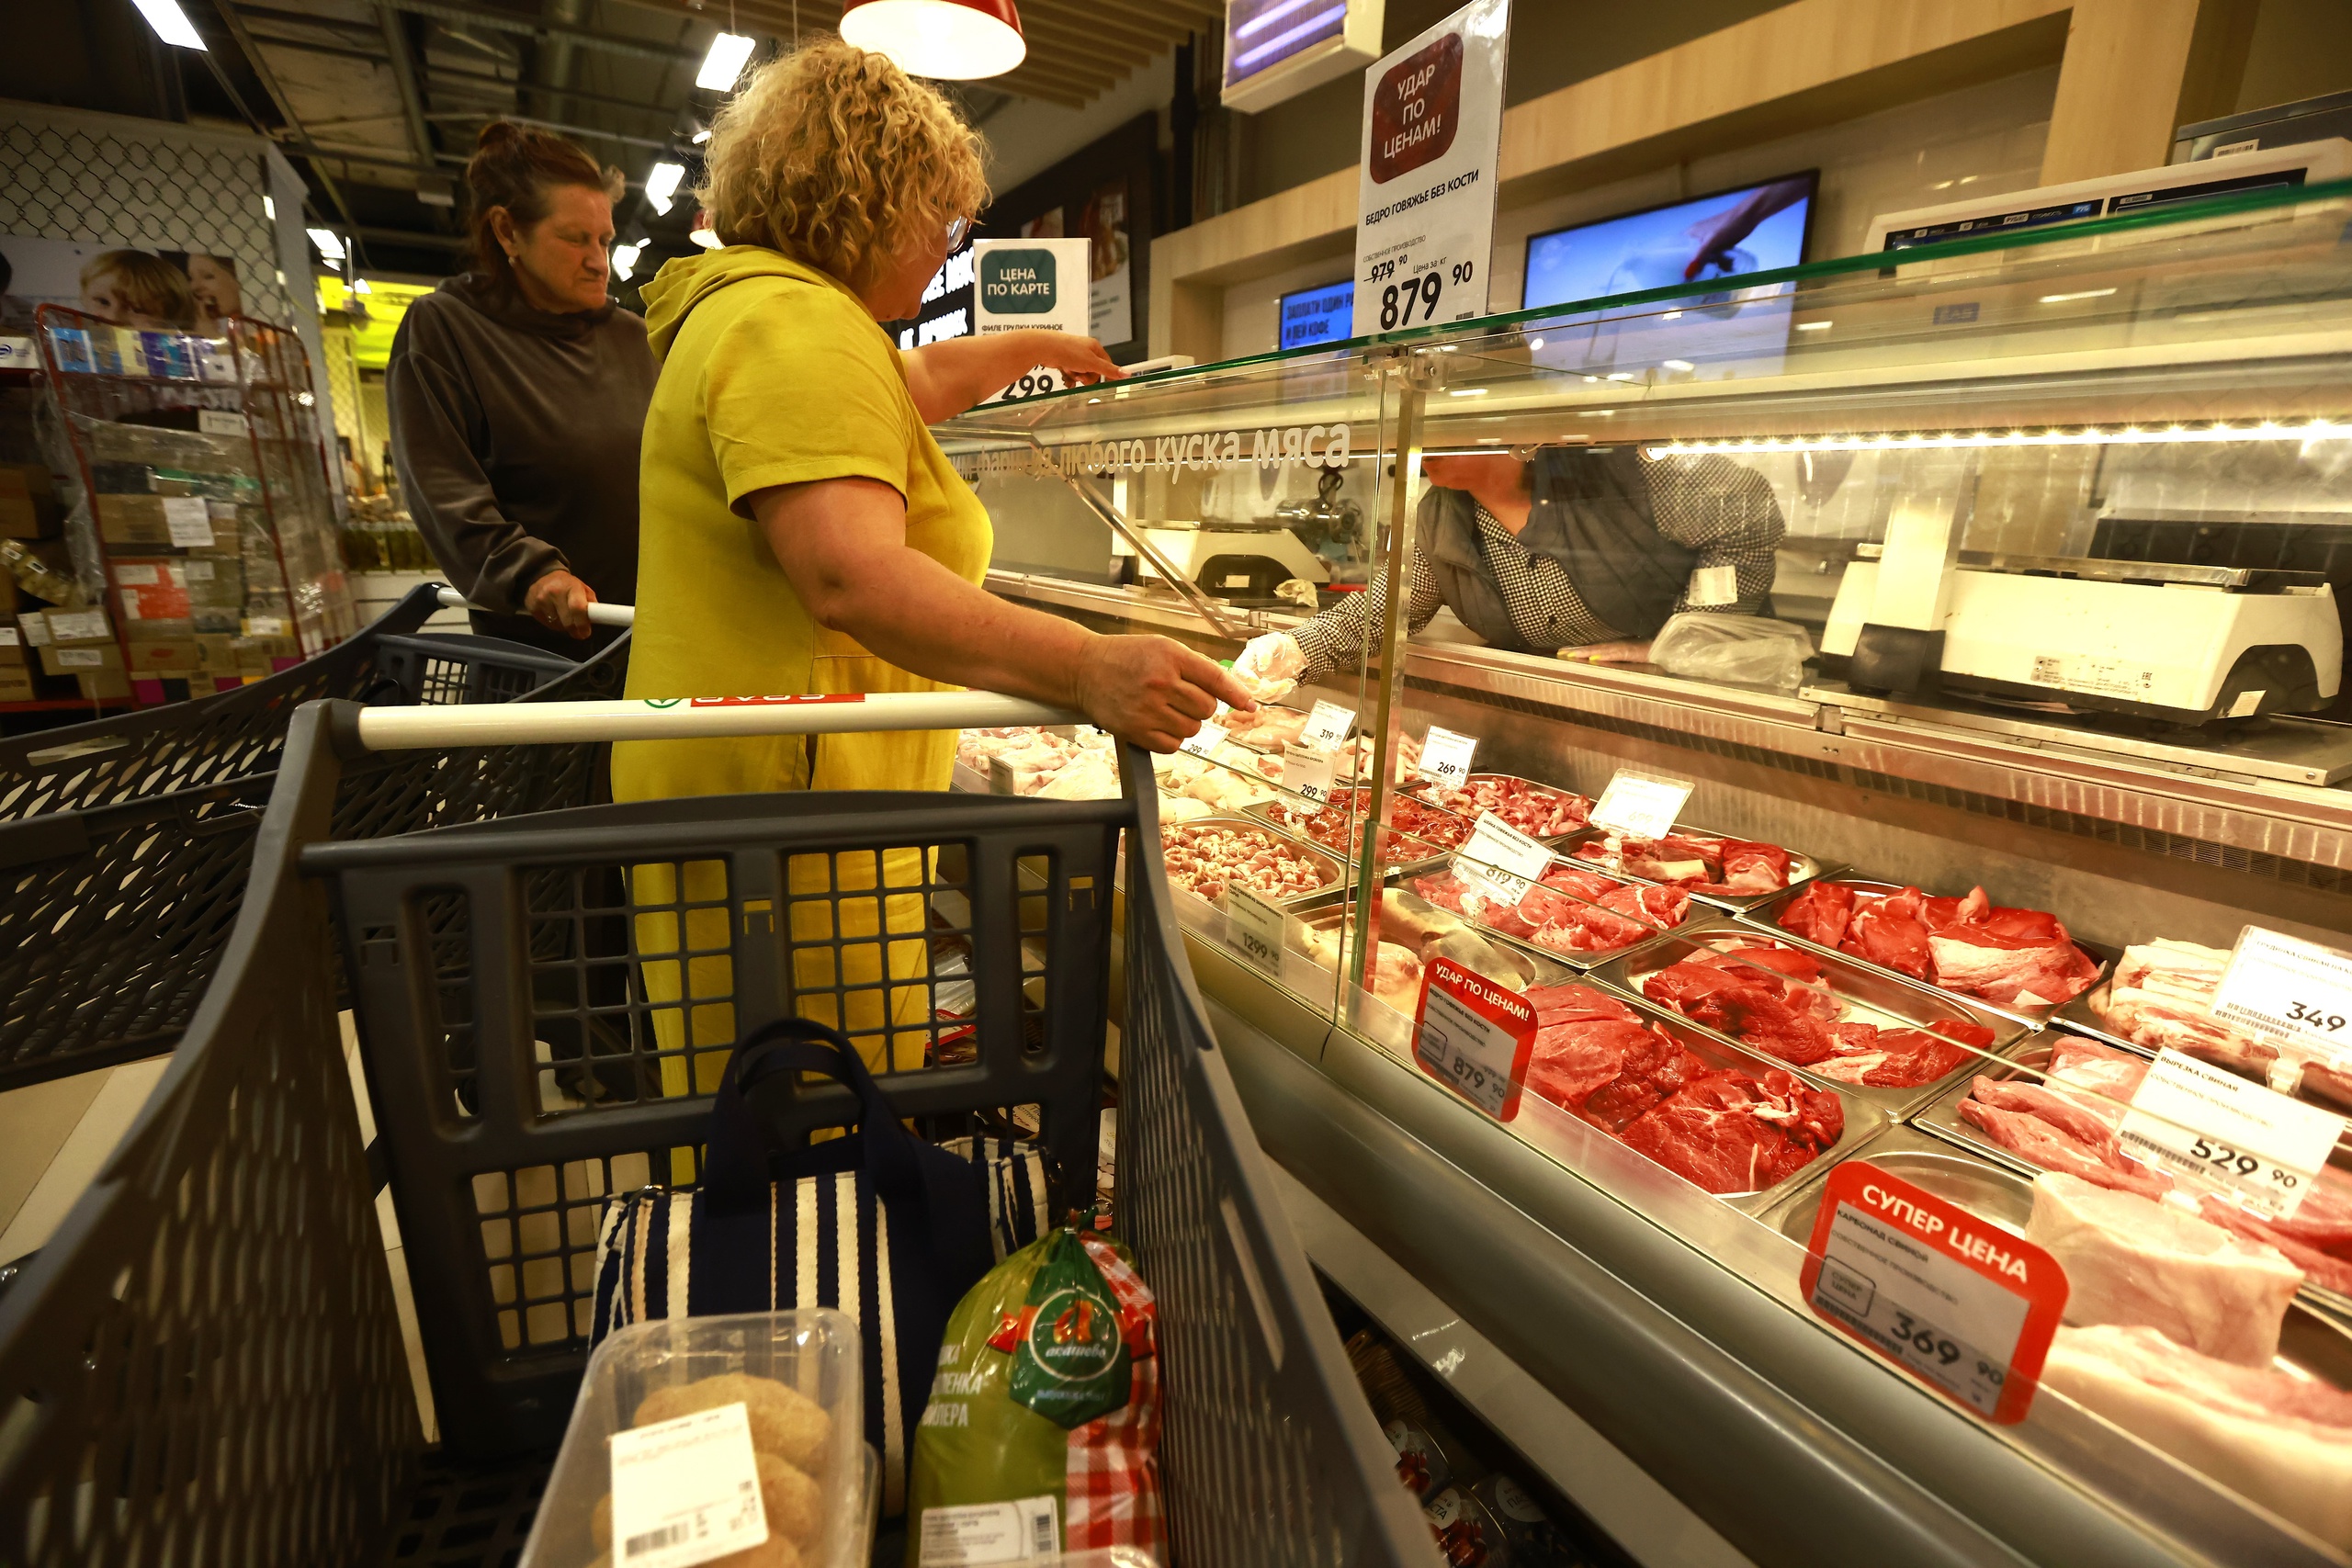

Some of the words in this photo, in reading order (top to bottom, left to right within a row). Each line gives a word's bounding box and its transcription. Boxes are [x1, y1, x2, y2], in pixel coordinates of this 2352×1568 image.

[1396, 63, 1435, 100] УДАР
[1403, 98, 1425, 125] ПО
[1384, 114, 1442, 159] ЦЕНАМ!
[1366, 207, 1390, 226] БЕДРО
[1392, 189, 1430, 215] ГОВЯЖЬЕ
[1430, 184, 1445, 199] БЕЗ
[1448, 169, 1479, 193] КОСТИ
[1363, 247, 1391, 263] СОБСТВЕННОЕ
[1392, 235, 1426, 253] ПРОИЗВОДСТВО
[1000, 268, 1036, 282] ЦЕНА
[1372, 260, 1395, 284] 979
[1399, 254, 1408, 265] 90
[1413, 262, 1429, 275] Цена
[1430, 258, 1438, 269] за
[988, 284, 1007, 296] ПО
[1011, 283, 1050, 295] КАРТЕ
[1381, 272, 1442, 331] 879
[1453, 261, 1473, 286] 90
[1001, 375, 1054, 400] 299
[1060, 435, 1146, 476] любого
[1155, 432, 1240, 485] куска
[1252, 423, 1351, 469] мяса
[1188, 744, 1202, 754] 299
[1320, 729, 1334, 740] 319
[1437, 761, 1455, 774] 269
[1301, 784, 1317, 797] 299
[1628, 811, 1654, 824] 699
[1476, 829, 1499, 843] СОБСТВЕННОЕ
[1499, 841, 1523, 857] ПРОИЗВОДСТВО
[1483, 818, 1496, 829] ШЕЙКА
[1519, 838, 1532, 849] КОСТИ
[1487, 864, 1511, 885] 819
[1516, 878, 1526, 889] 90
[1243, 932, 1267, 958] 1299
[1272, 951, 1279, 961] 90
[1436, 964, 1463, 984] УДАР
[1464, 978, 1482, 996] ПО
[1483, 988, 1530, 1021] ЦЕНАМ!
[1474, 1016, 1490, 1033] КОСТИ
[2286, 1001, 2346, 1032] 349
[1453, 1056, 1485, 1089] 879
[1492, 1083, 1505, 1099] 90
[2160, 1055, 2199, 1077] ВЫРЕЗКА
[2201, 1073, 2239, 1092] СВИНАЯ
[2190, 1137, 2258, 1177] 529
[2272, 1168, 2297, 1189] 90
[1838, 1209, 1885, 1241] КАРБОНАД
[1887, 1236, 1929, 1263] СВИНОЙ
[1861, 1184, 1945, 1235] СУПЕР
[1948, 1225, 2029, 1284] ЦЕНА
[1831, 1229, 1887, 1265] СОБСТВЕННОЕ
[1889, 1260, 1958, 1304] ПРОИЗВОДСТВО
[1891, 1311, 1961, 1365] 369
[1977, 1360, 2004, 1386] 90
